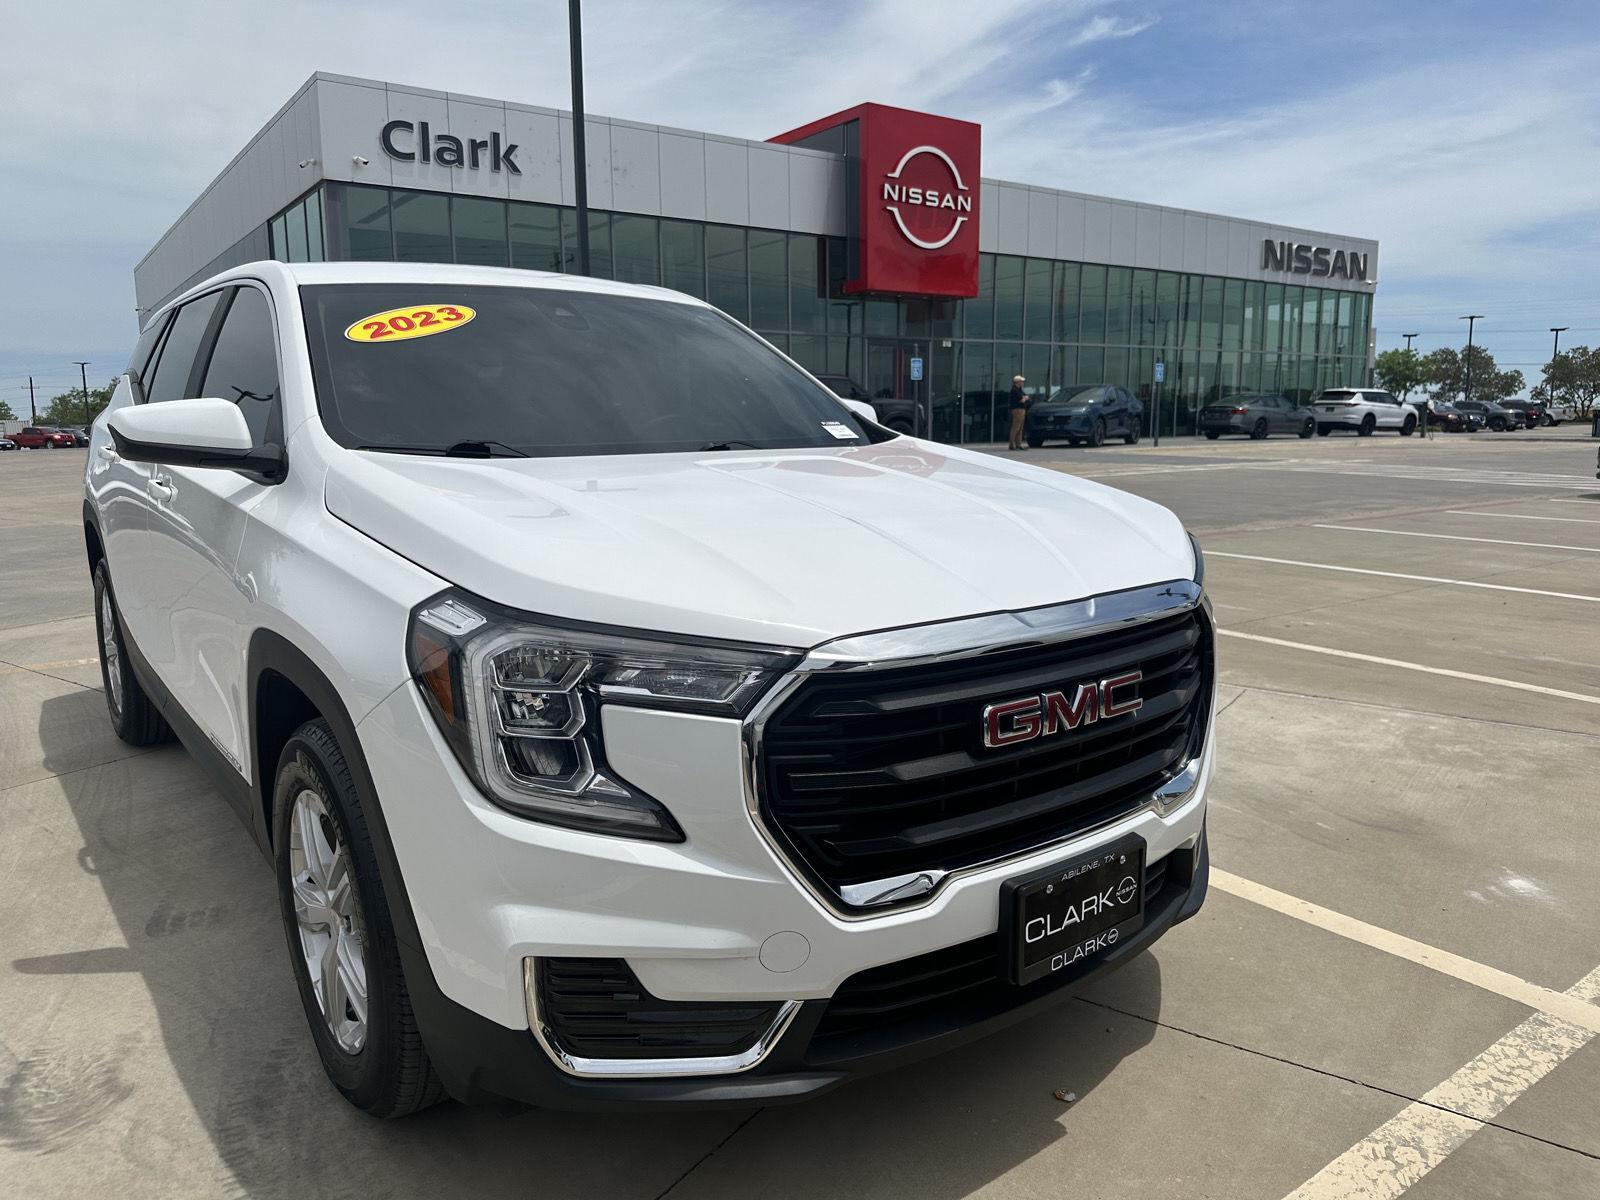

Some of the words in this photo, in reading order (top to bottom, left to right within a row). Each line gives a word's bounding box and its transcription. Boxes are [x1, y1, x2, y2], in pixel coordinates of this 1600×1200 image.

[381, 120, 521, 175] Clark
[884, 183, 971, 212] NISSAN
[1263, 239, 1368, 281] NISSAN
[363, 307, 466, 340] 2023
[983, 670, 1143, 747] GMC
[1103, 853, 1115, 864] TX
[1025, 886, 1115, 943] CLARK
[1051, 933, 1107, 971] CLARK
